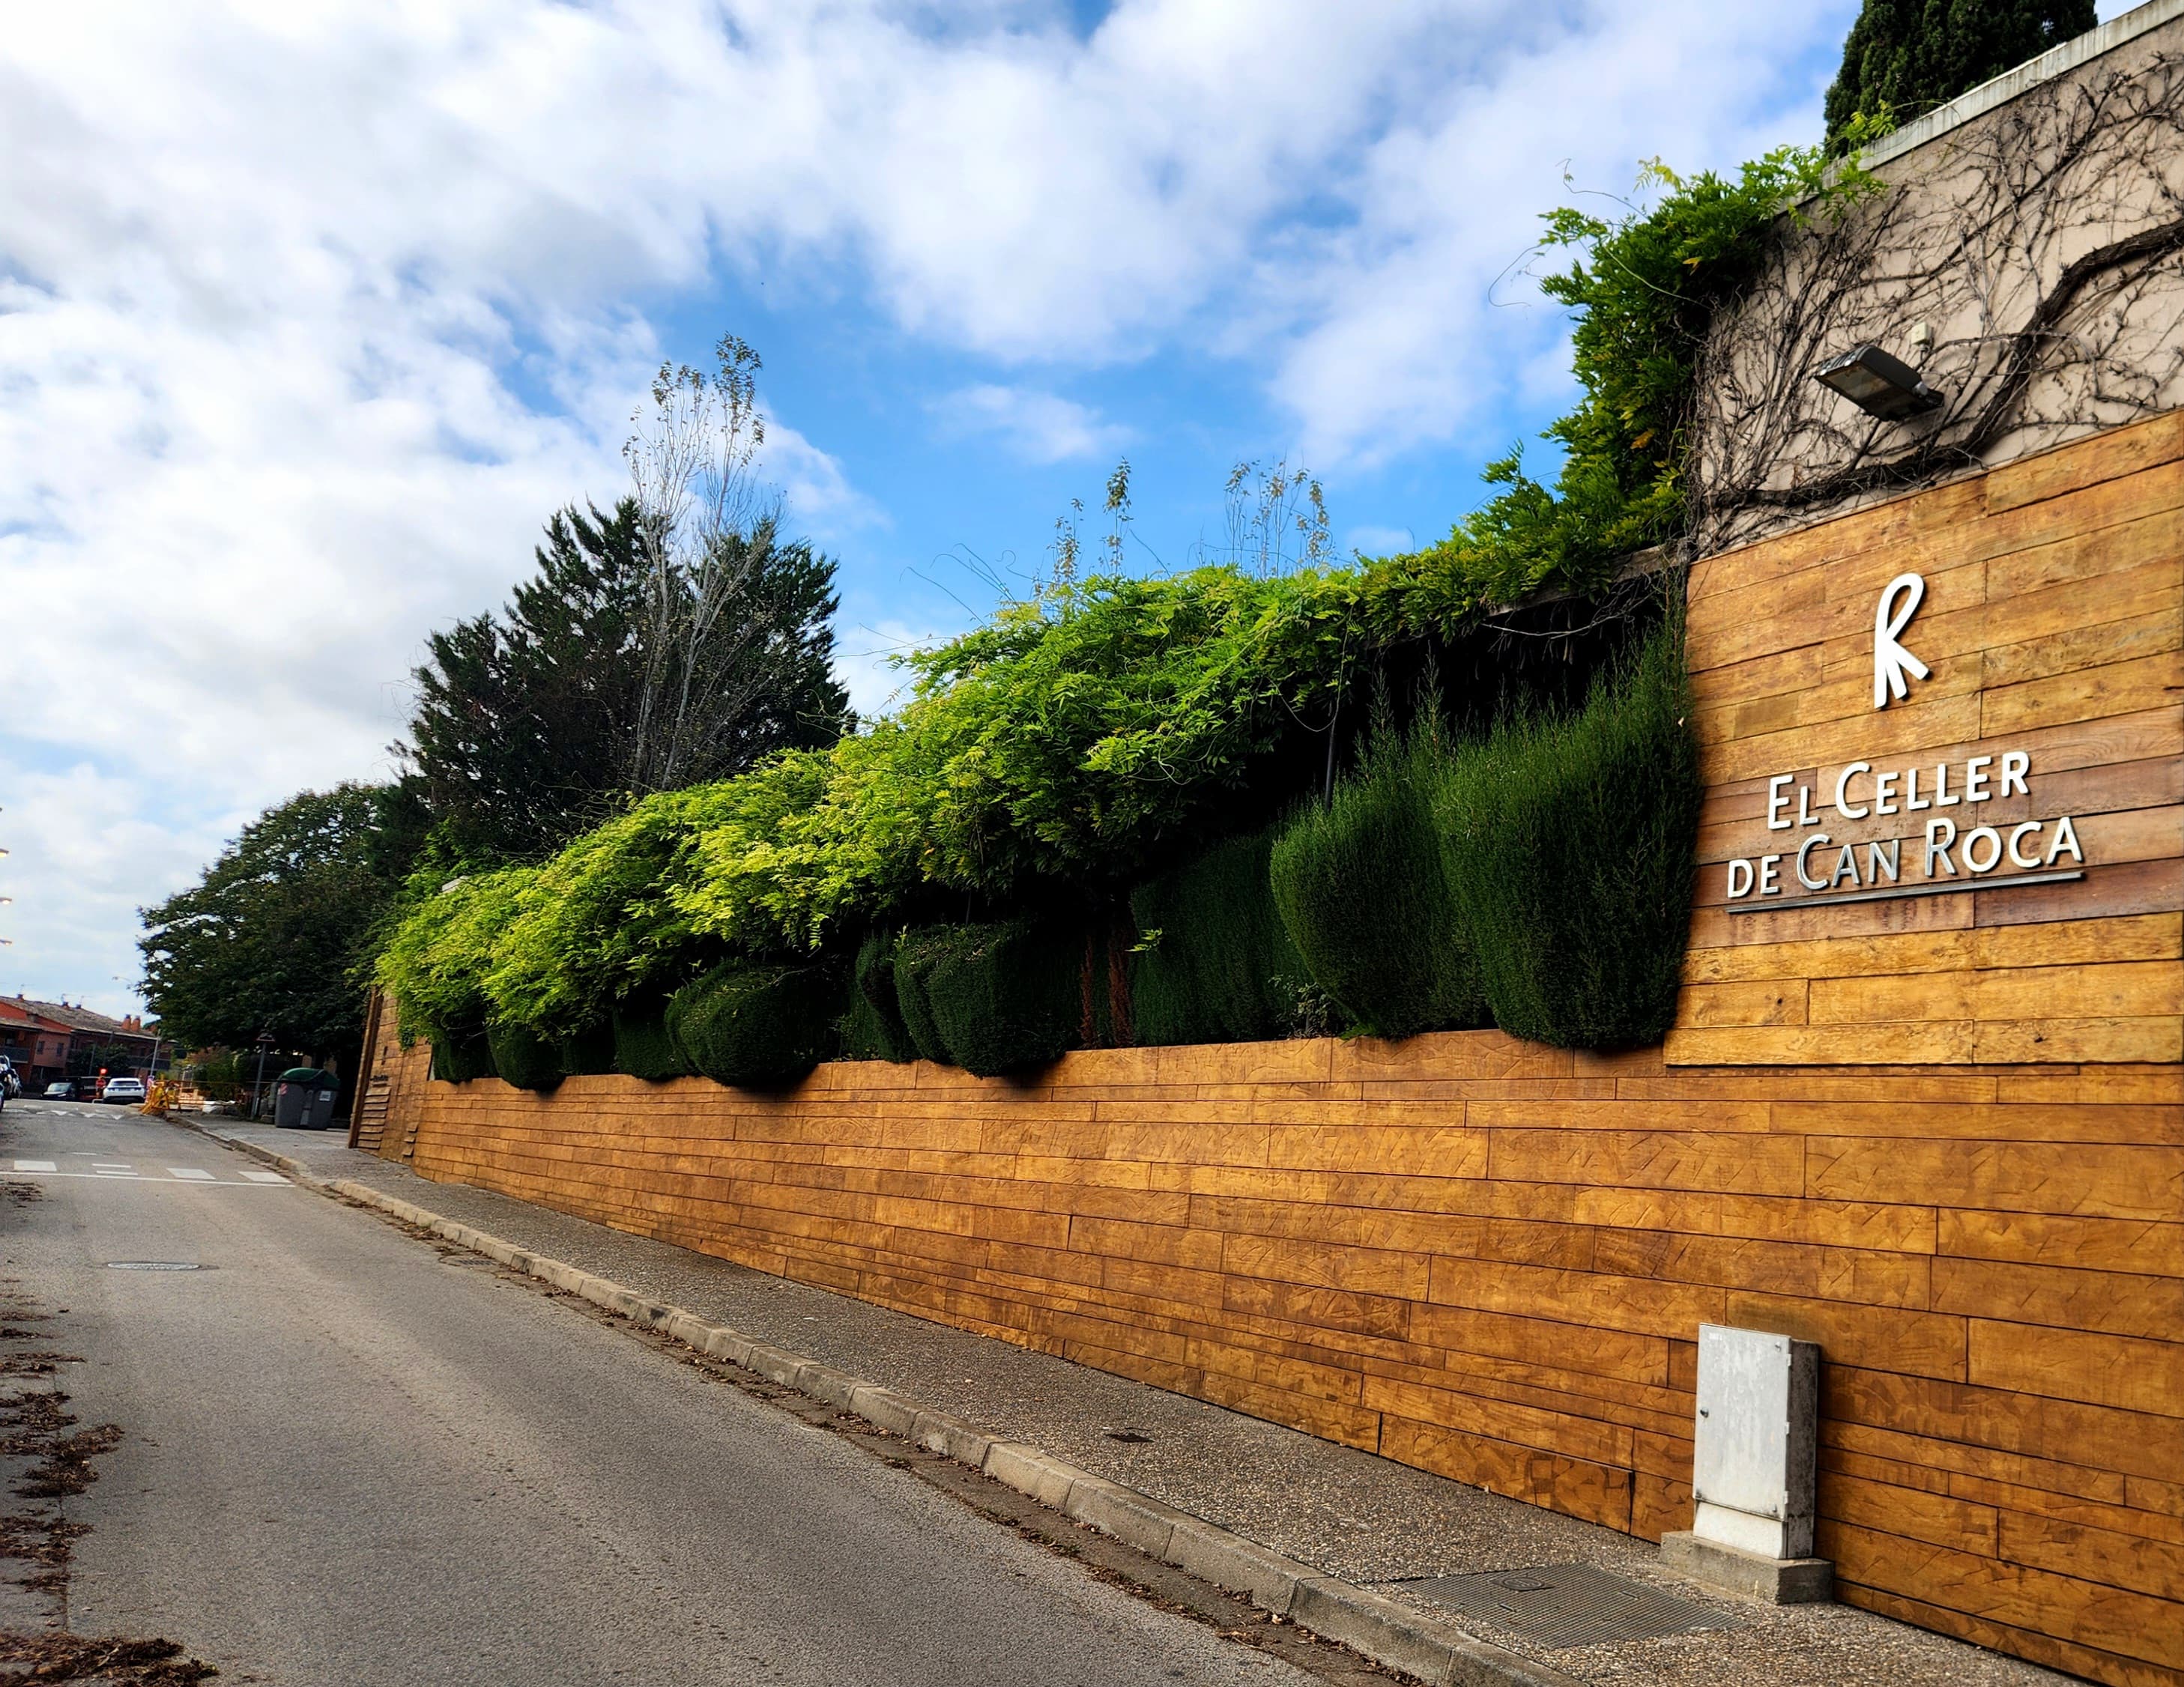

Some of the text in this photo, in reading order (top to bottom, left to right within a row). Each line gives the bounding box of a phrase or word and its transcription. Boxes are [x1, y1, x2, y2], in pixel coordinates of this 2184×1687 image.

[1767, 751, 2030, 830] EL CELLER
[1727, 817, 2084, 898] DE CAN ROCA
